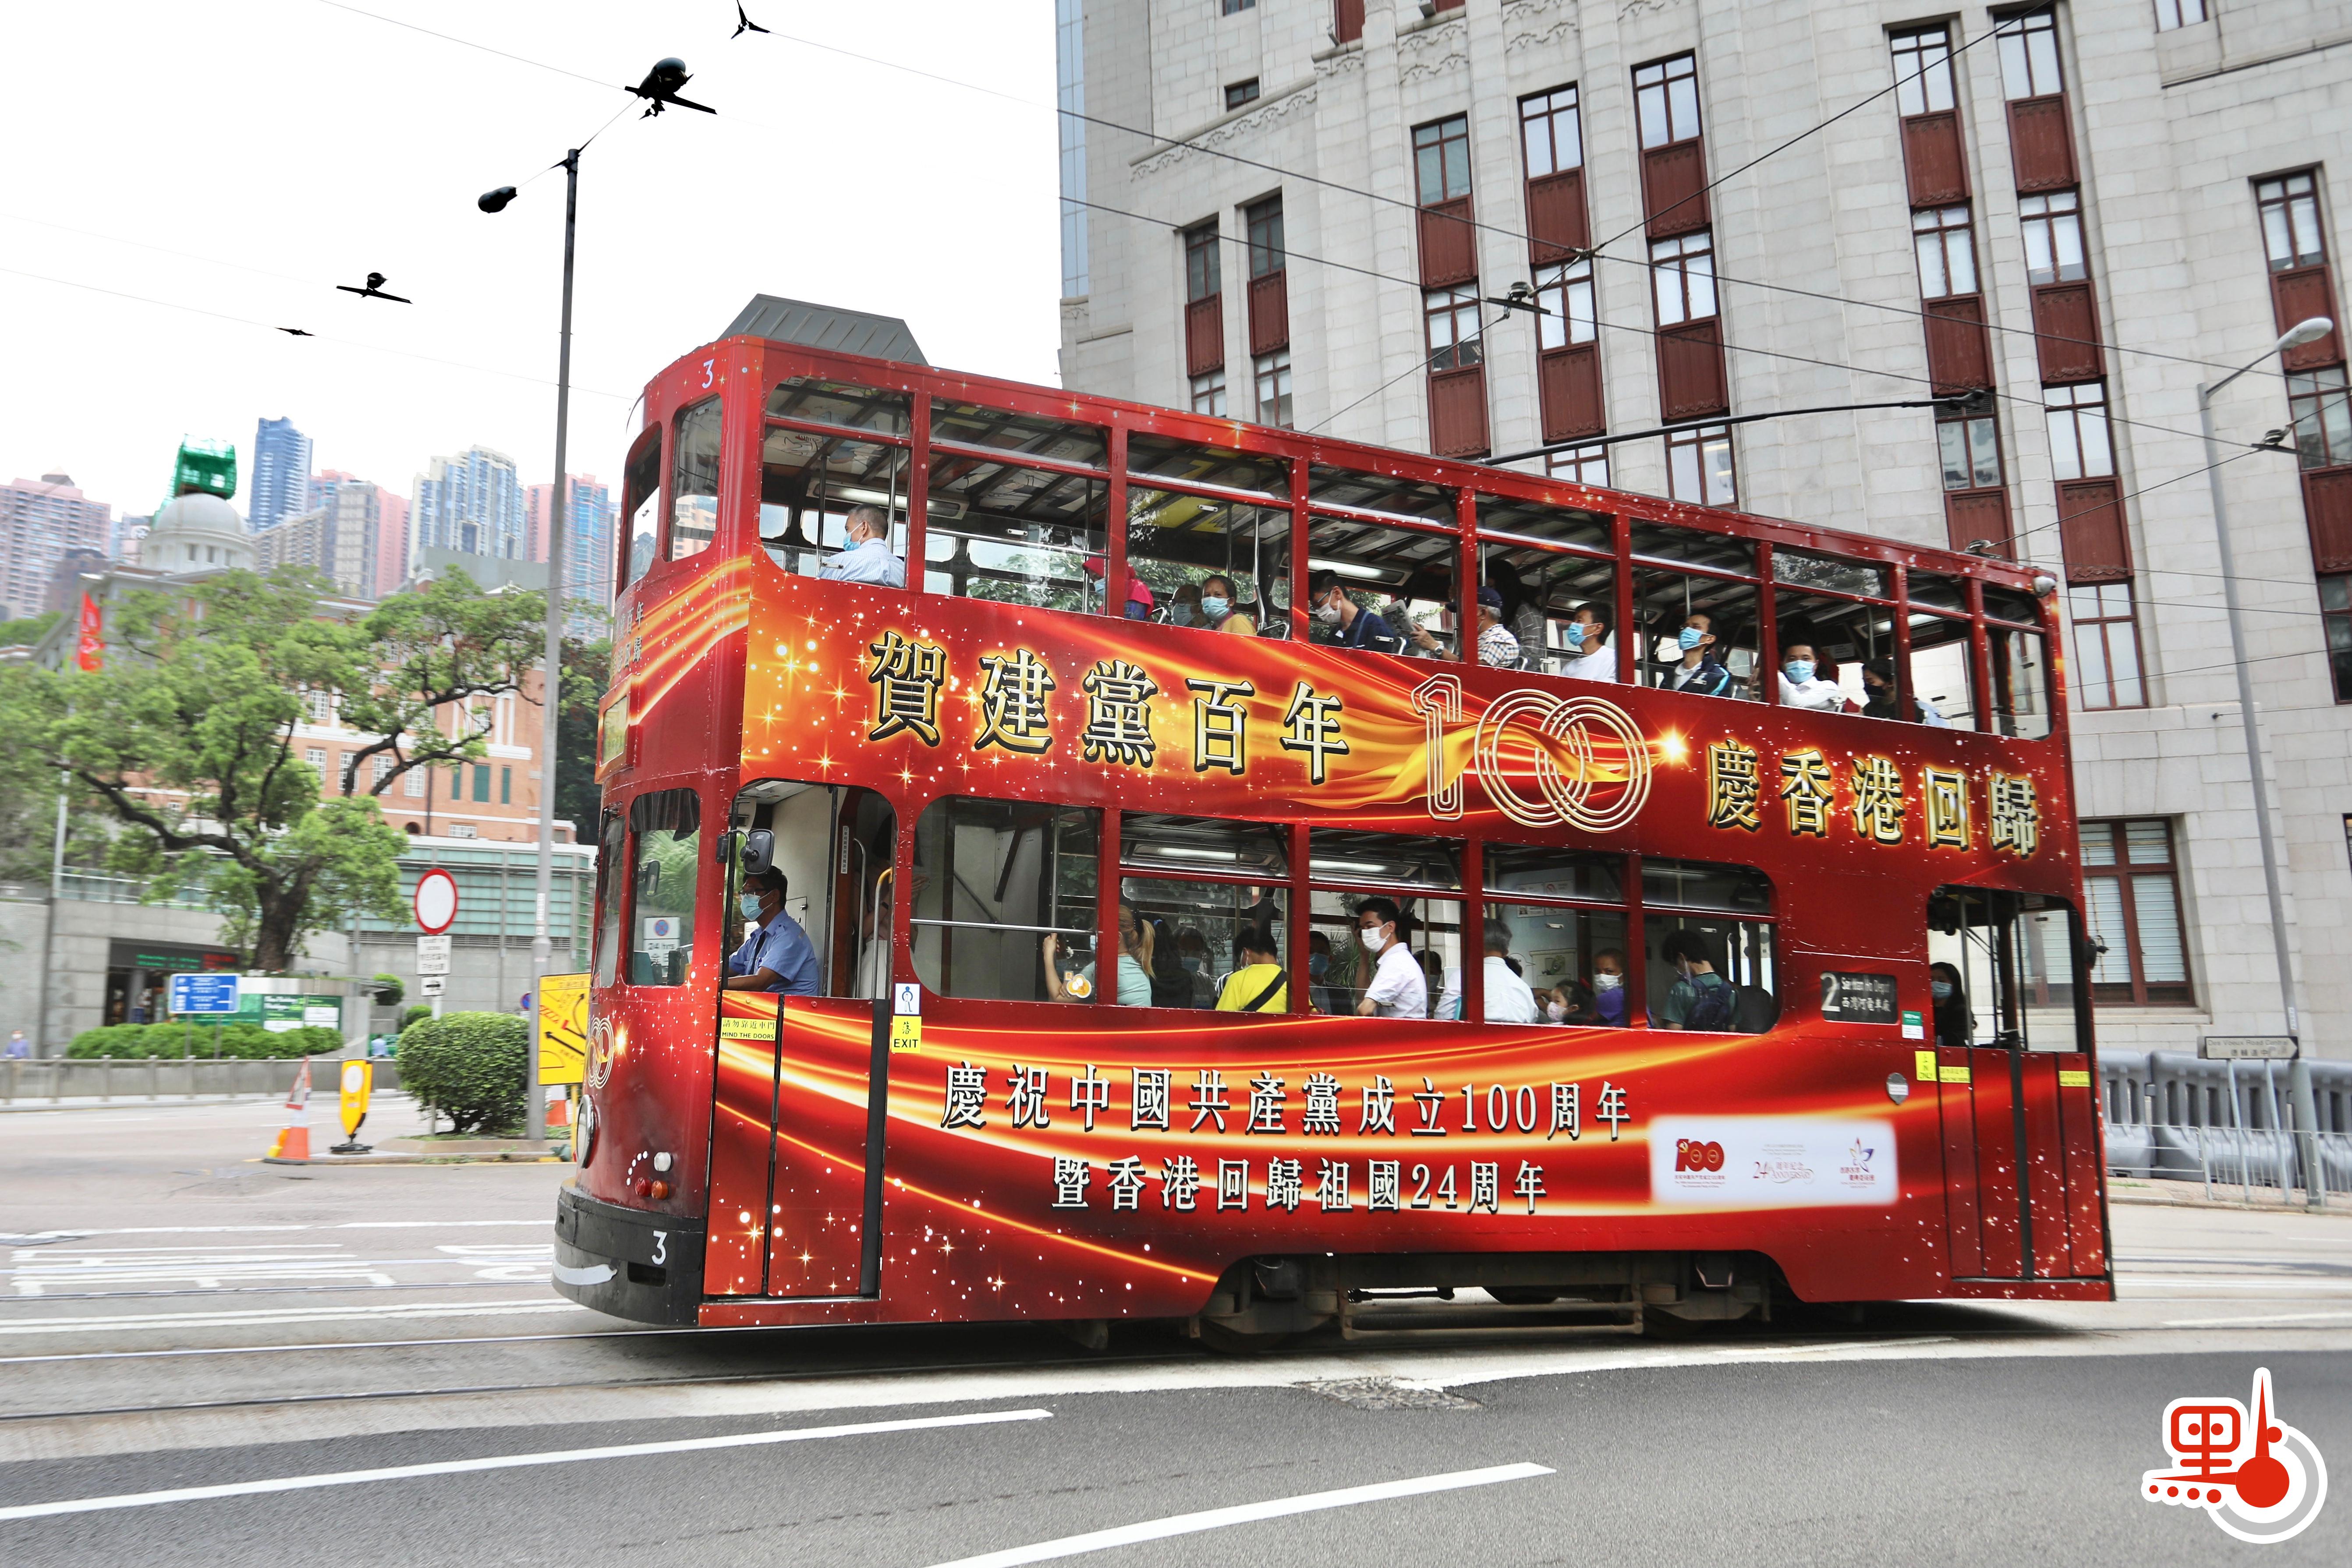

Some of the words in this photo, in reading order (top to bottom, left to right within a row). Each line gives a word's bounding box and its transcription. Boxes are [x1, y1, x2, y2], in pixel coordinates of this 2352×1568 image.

[701, 358, 715, 389] 3
[868, 630, 1350, 786] 賀建黨百年
[1410, 673, 1653, 833] 100
[1706, 739, 2040, 859] 慶香港回歸
[1819, 972, 1841, 1012] 2
[723, 1019, 775, 1030] 請勿靠近車門
[894, 1038, 919, 1048] EXIT
[902, 1021, 911, 1034] 落
[941, 1060, 1631, 1141] 慶祝中國共產黨成立100周年
[1675, 1139, 1724, 1172] 100
[1052, 1154, 1547, 1215] 暨香港回歸祖國24周年
[652, 1231, 668, 1266] 3
